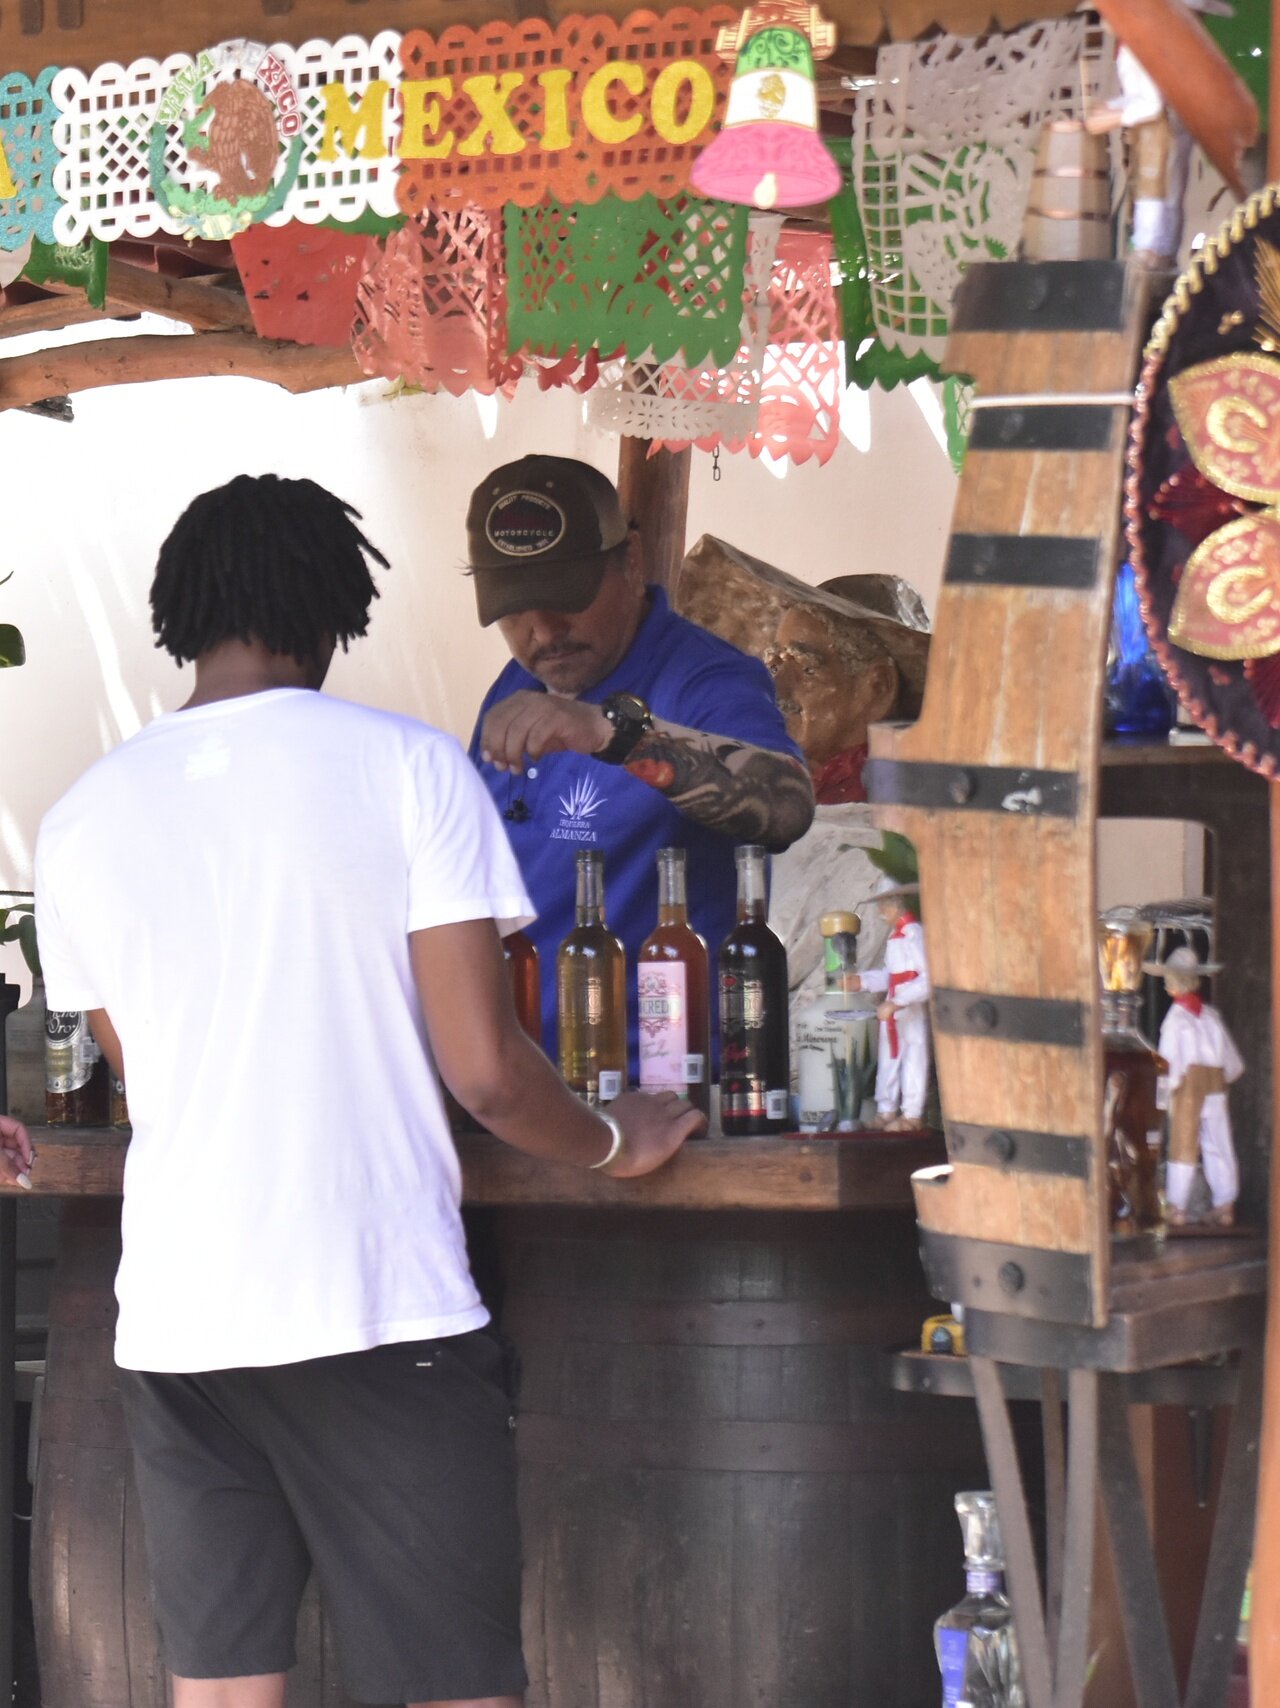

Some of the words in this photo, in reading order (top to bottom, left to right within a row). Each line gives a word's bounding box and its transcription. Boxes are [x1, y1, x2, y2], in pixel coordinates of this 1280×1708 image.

[156, 51, 215, 124] VIVA
[319, 60, 716, 161] MEXICO
[494, 529, 555, 537] MOTORCYCLE
[549, 828, 597, 842] ALMANZA
